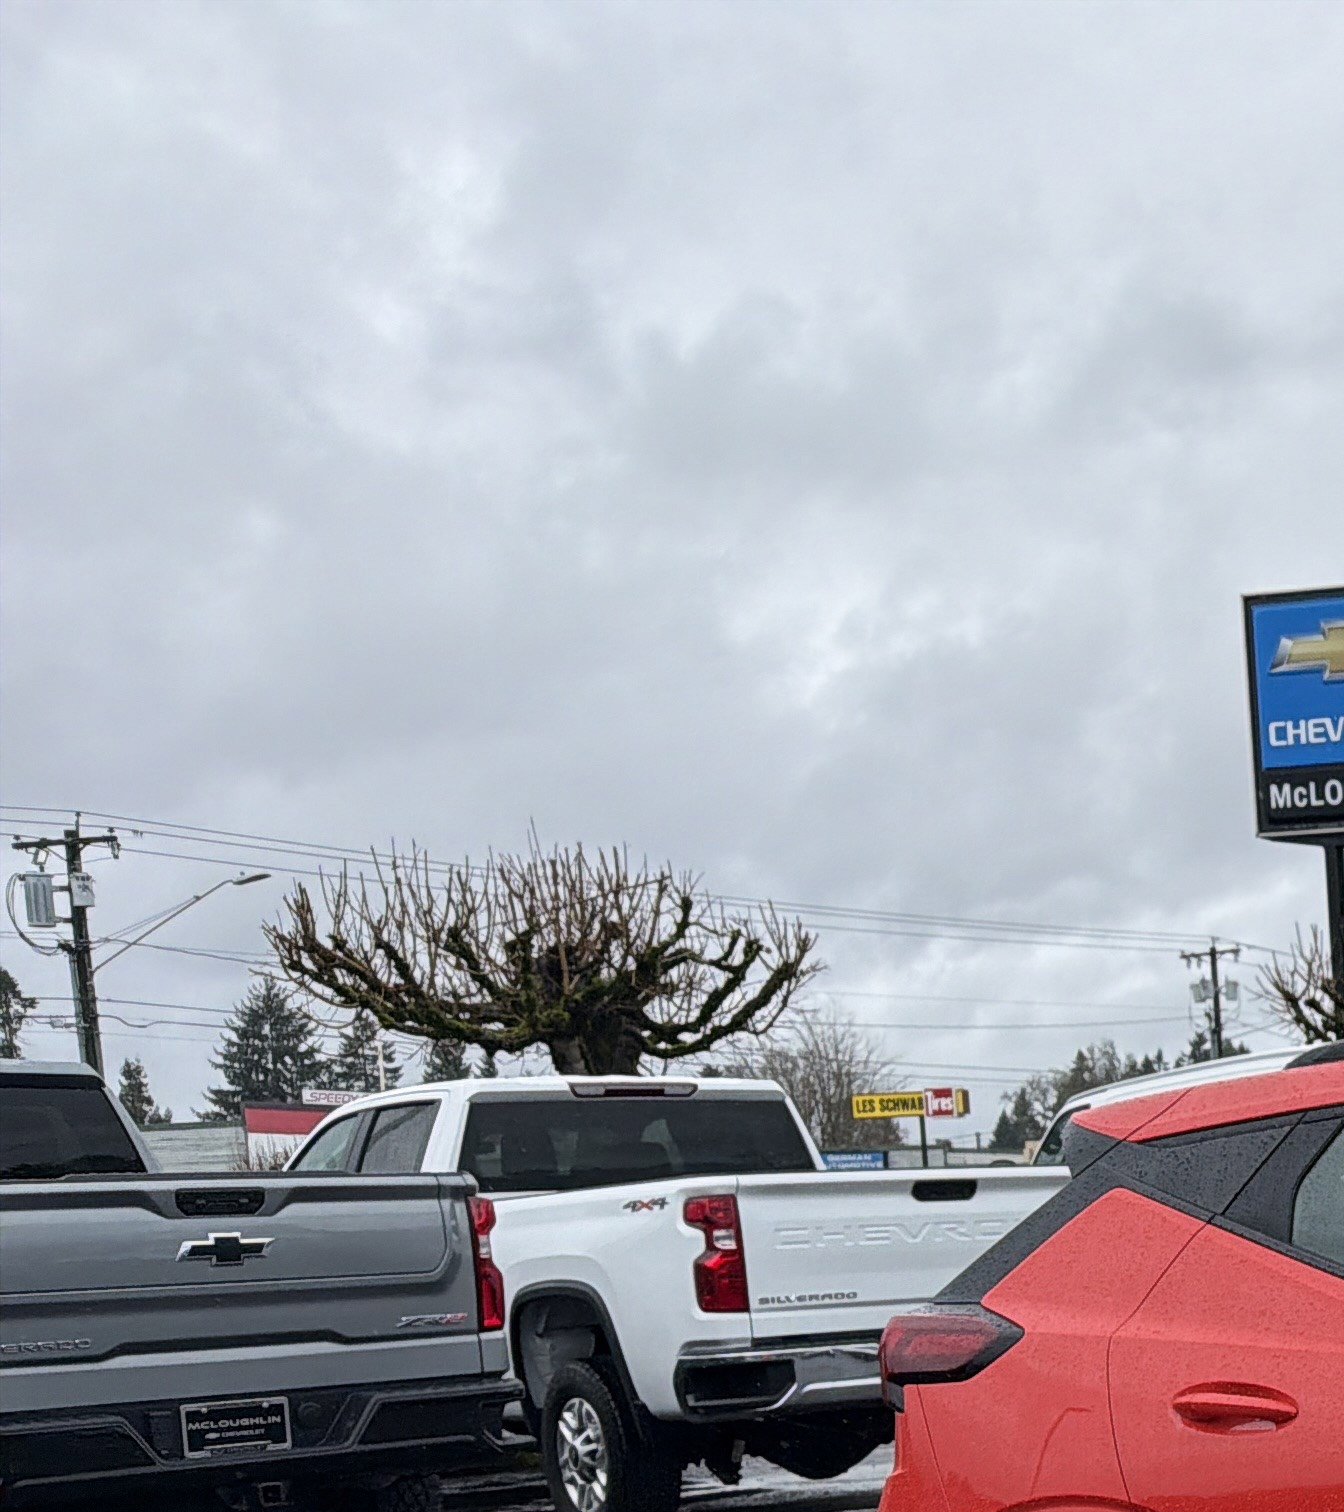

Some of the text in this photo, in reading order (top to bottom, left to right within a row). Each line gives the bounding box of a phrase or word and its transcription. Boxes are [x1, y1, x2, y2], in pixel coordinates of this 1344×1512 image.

[856, 1090, 955, 1115] LES SCHWAB Tires
[774, 1218, 1022, 1249] CHEVRO
[758, 1291, 857, 1305] SILVERADO
[187, 1415, 281, 1430] MCLOUGHLIN
